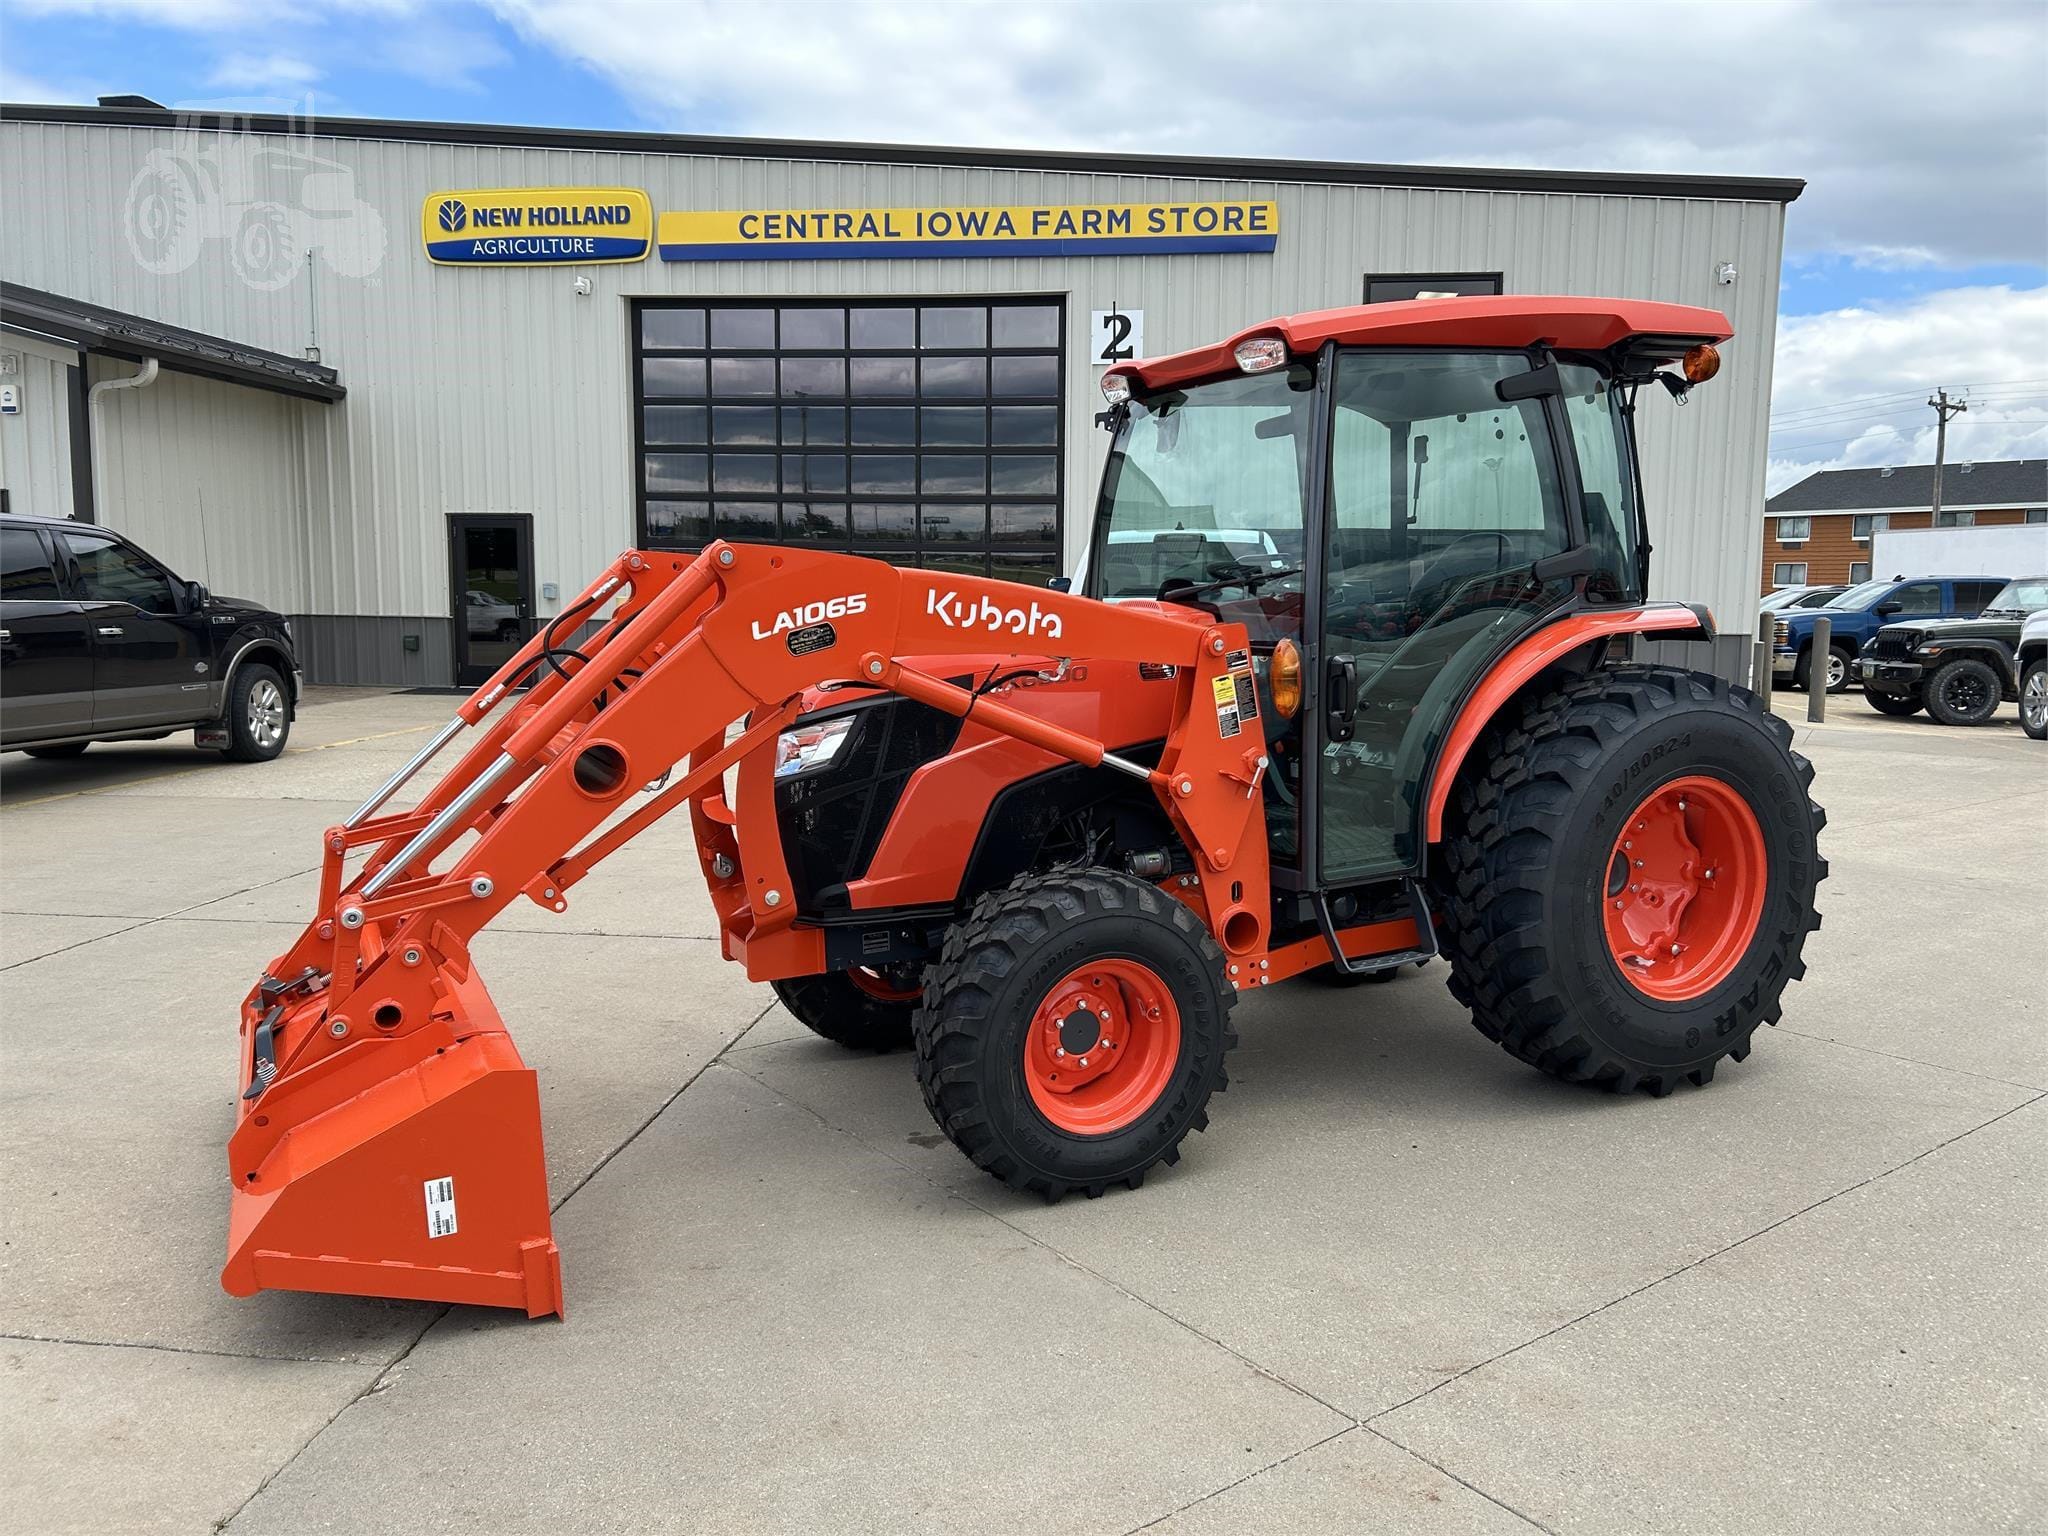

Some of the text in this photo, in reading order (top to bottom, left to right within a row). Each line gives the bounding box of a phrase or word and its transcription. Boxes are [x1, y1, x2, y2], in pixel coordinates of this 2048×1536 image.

[472, 205, 631, 227] NEW HOLLAND
[738, 205, 1268, 240] CENTRAL IOWA FARM STORE
[472, 238, 595, 255] AGRICULTURE
[1101, 314, 1133, 359] 2
[751, 593, 866, 640] LA1065
[926, 588, 1063, 638] Kubota
[1714, 773, 1808, 1037] GOODYEAR
[1155, 956, 1210, 1136] GOODYEAR
